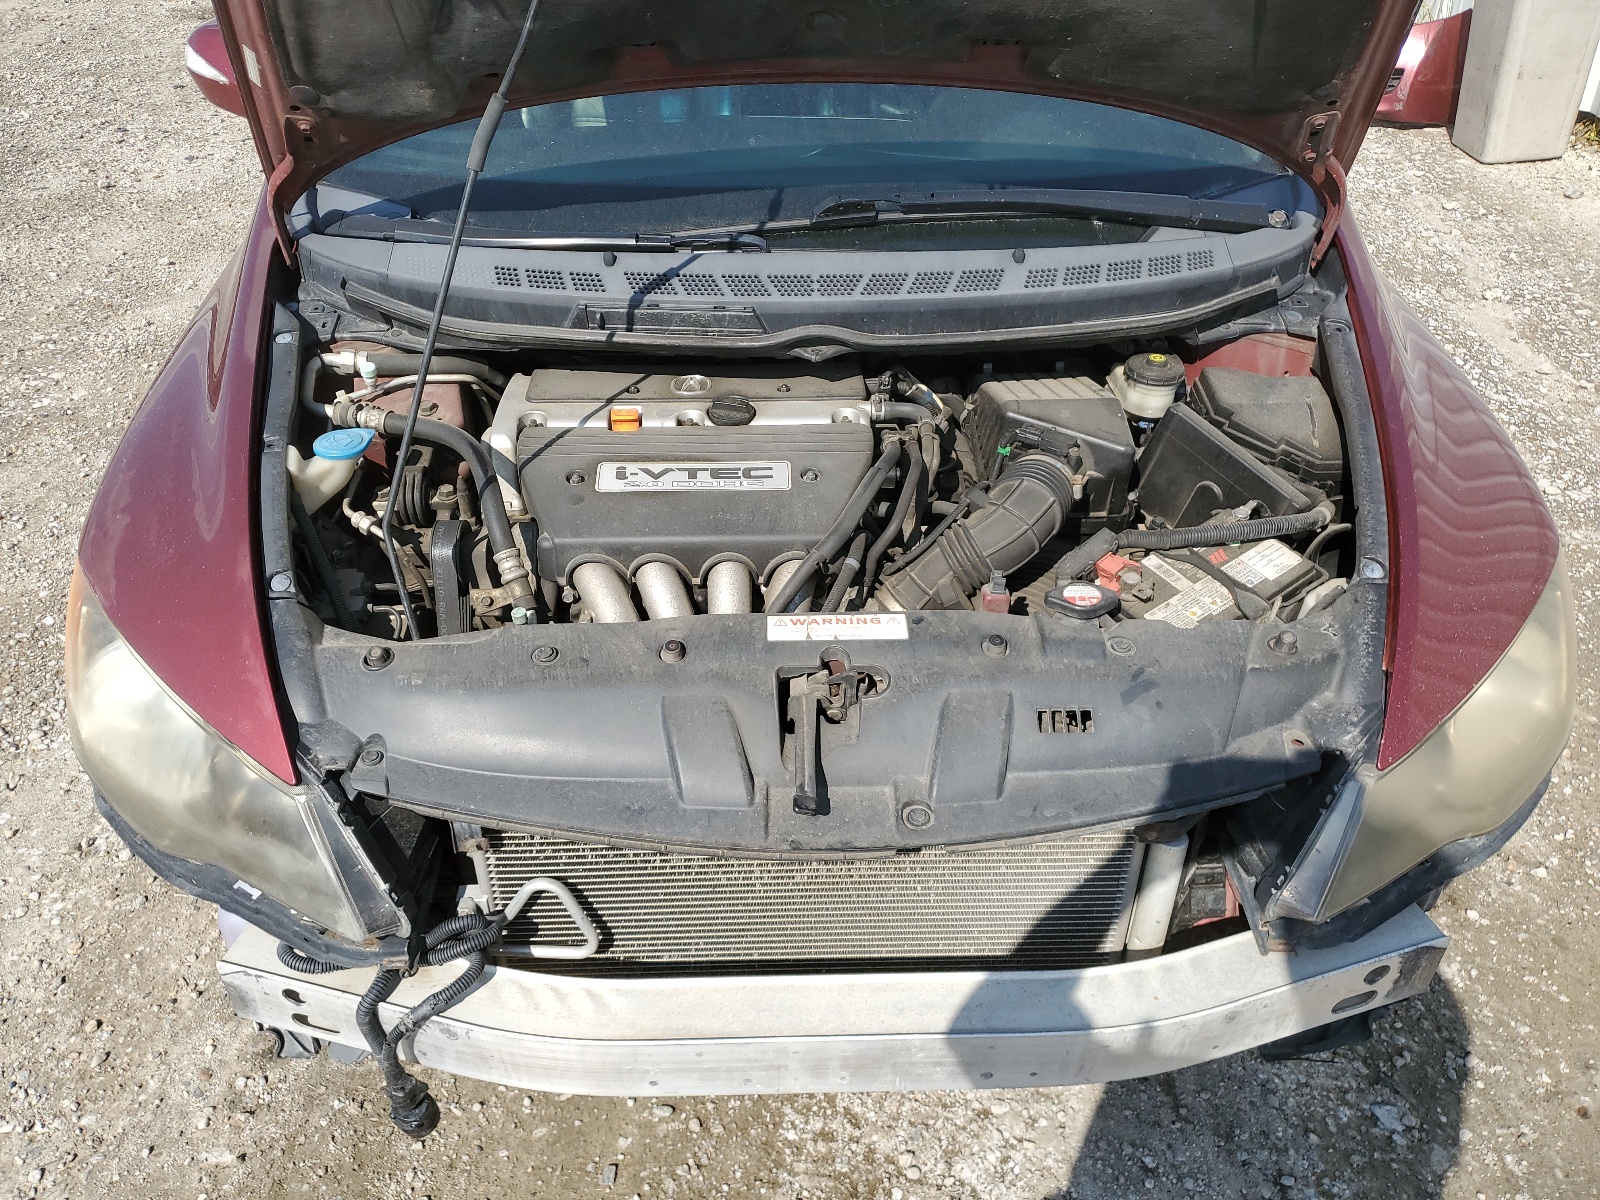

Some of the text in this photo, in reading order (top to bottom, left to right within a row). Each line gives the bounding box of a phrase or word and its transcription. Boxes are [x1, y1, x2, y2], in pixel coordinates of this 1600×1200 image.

[615, 466, 773, 480] i-VTEC
[623, 480, 765, 488] 2.0 DOHC
[789, 617, 882, 626] WARNING
